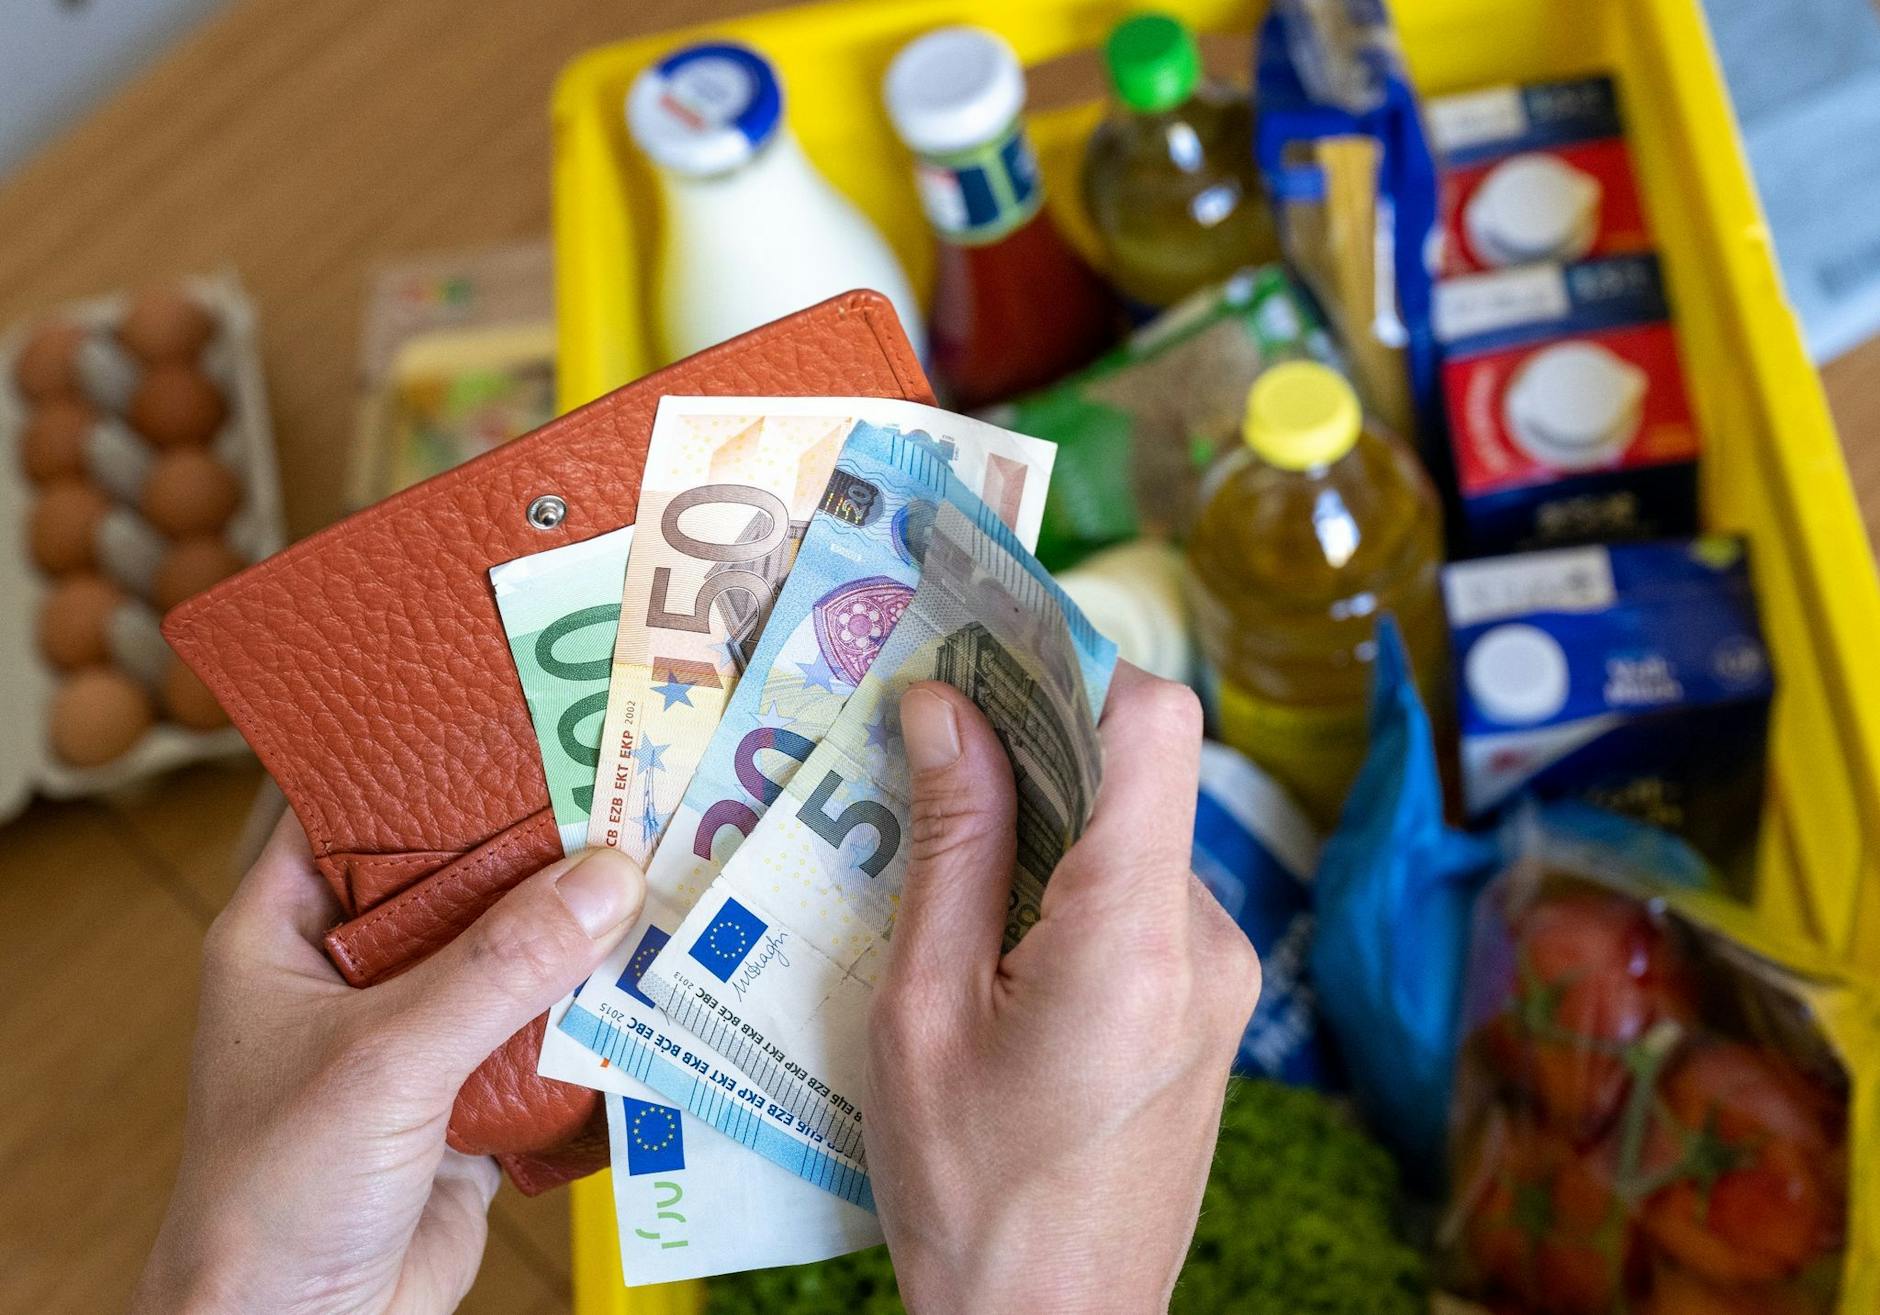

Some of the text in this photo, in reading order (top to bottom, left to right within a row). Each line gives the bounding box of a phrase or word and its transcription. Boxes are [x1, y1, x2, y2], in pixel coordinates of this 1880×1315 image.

[646, 484, 790, 642] 50
[606, 700, 636, 848] CB EZB EKT EKP 2002
[795, 769, 901, 879] 5
[673, 971, 695, 990] 2013
[695, 987, 719, 1010] EBC
[599, 1002, 625, 1022] 2015
[626, 1017, 654, 1040] EBC
[740, 1023, 765, 1045] EKB
[682, 1050, 710, 1074] EKB
[761, 1042, 786, 1063] EKT
[709, 1070, 737, 1092] EKT
[784, 1062, 808, 1081] EKP
[737, 1087, 766, 1110] EKP
[807, 1077, 831, 1098] EZB
[767, 1103, 795, 1126] EZB
